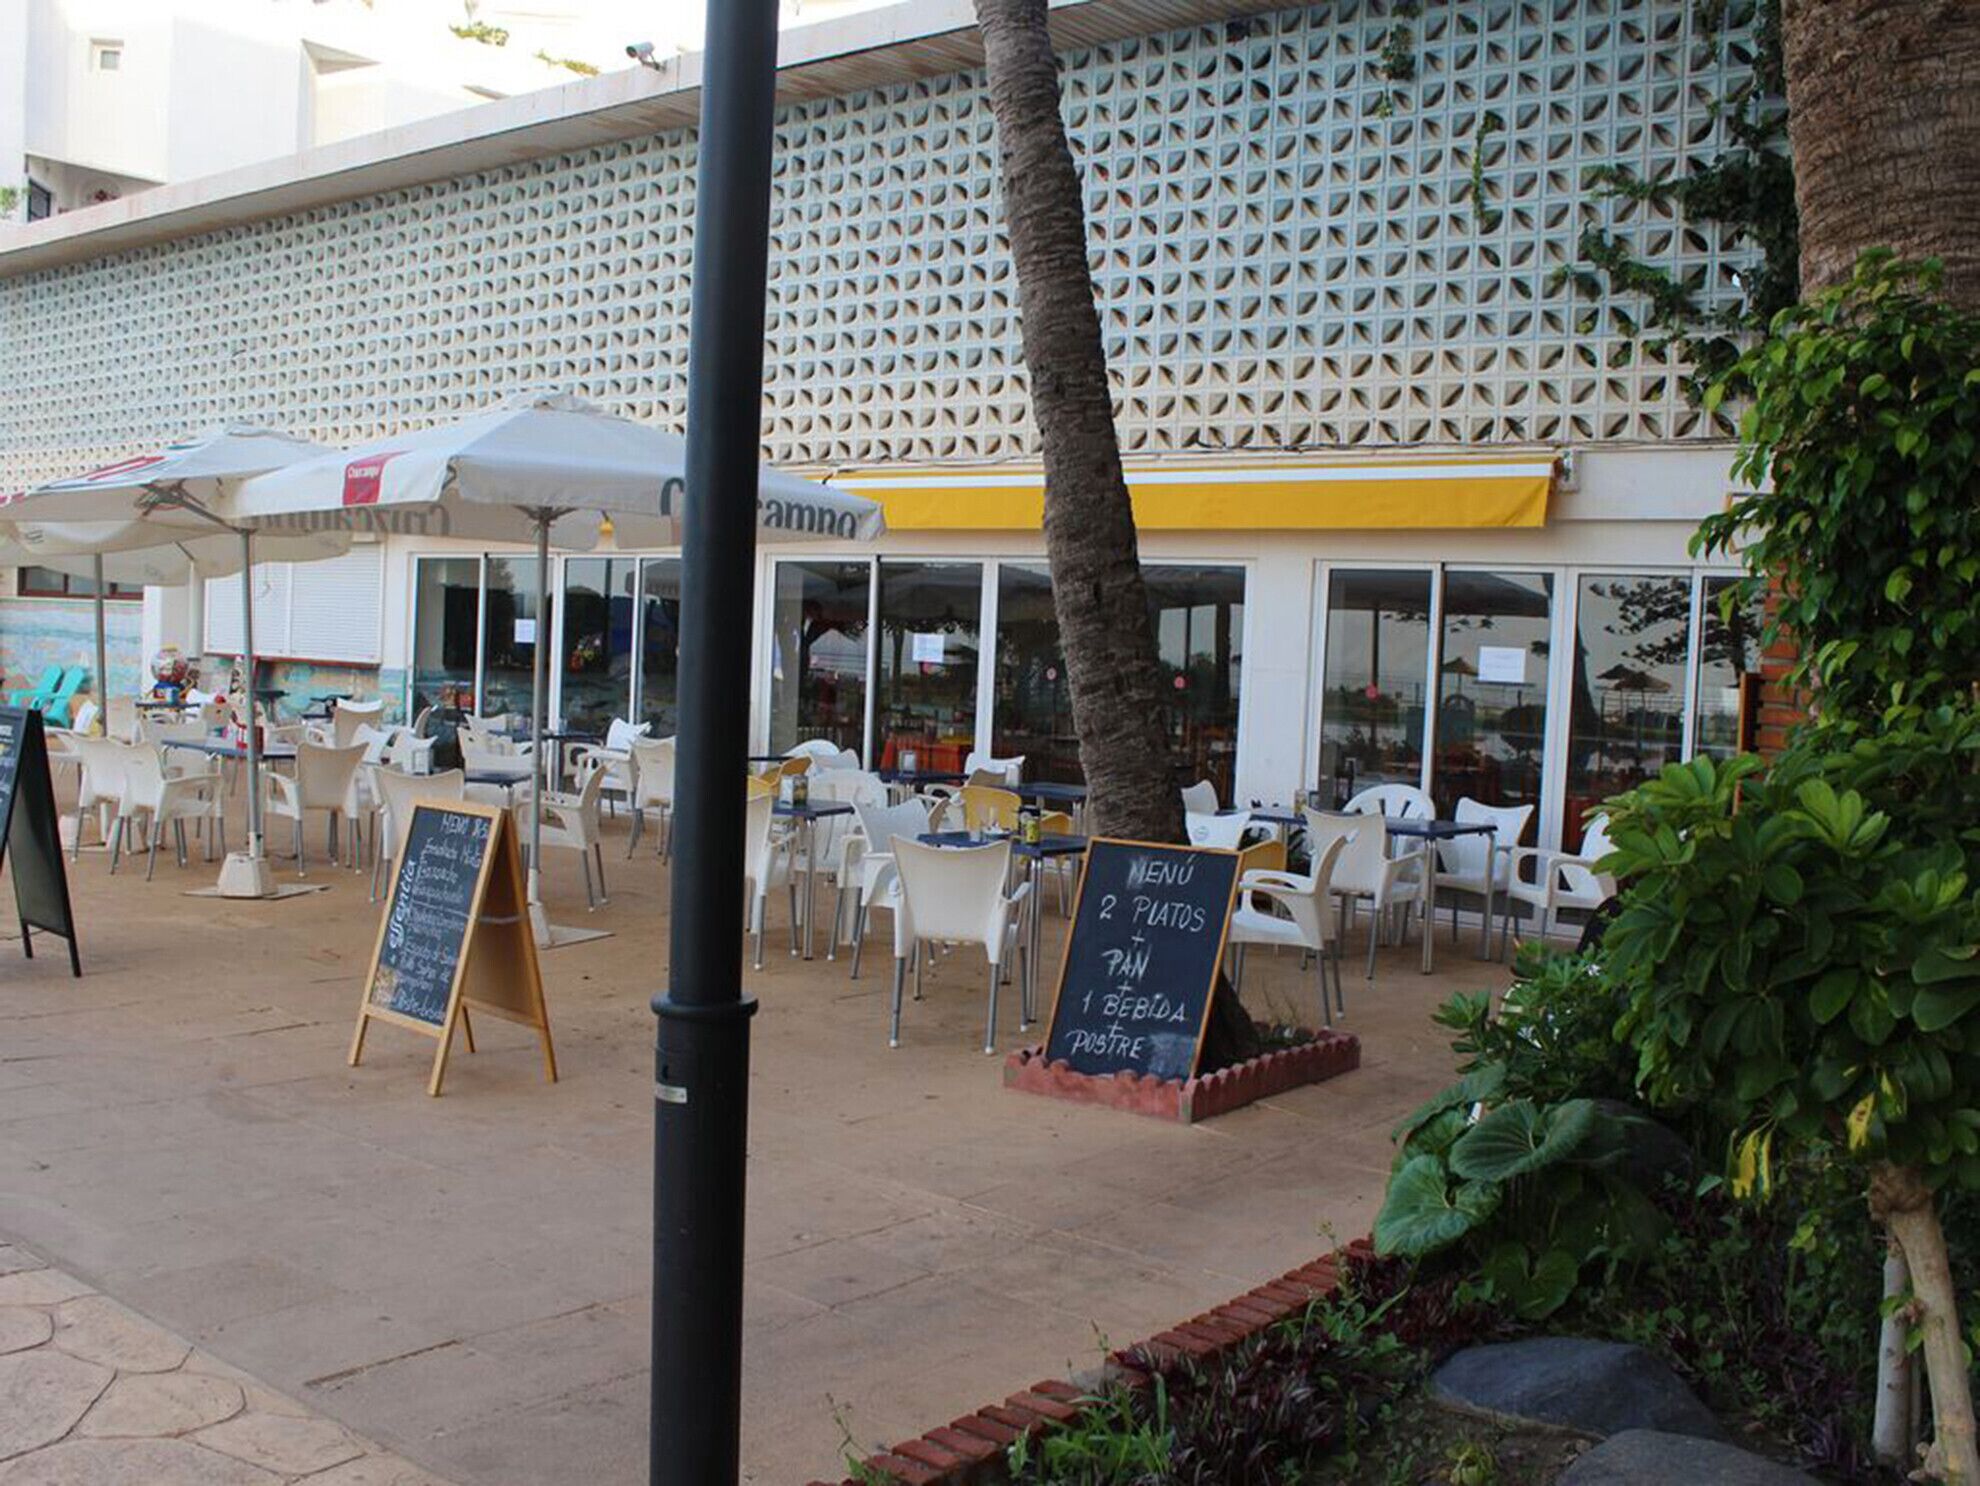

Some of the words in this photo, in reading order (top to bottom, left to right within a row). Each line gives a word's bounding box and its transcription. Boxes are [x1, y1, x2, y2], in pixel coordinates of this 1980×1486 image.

[1128, 854, 1196, 887] MENÚ
[1099, 894, 1118, 920] 2
[1133, 895, 1206, 932] PLATOS
[1101, 945, 1151, 979] PAN
[1082, 990, 1093, 1013] 1
[1066, 1029, 1146, 1060] POSTRE
